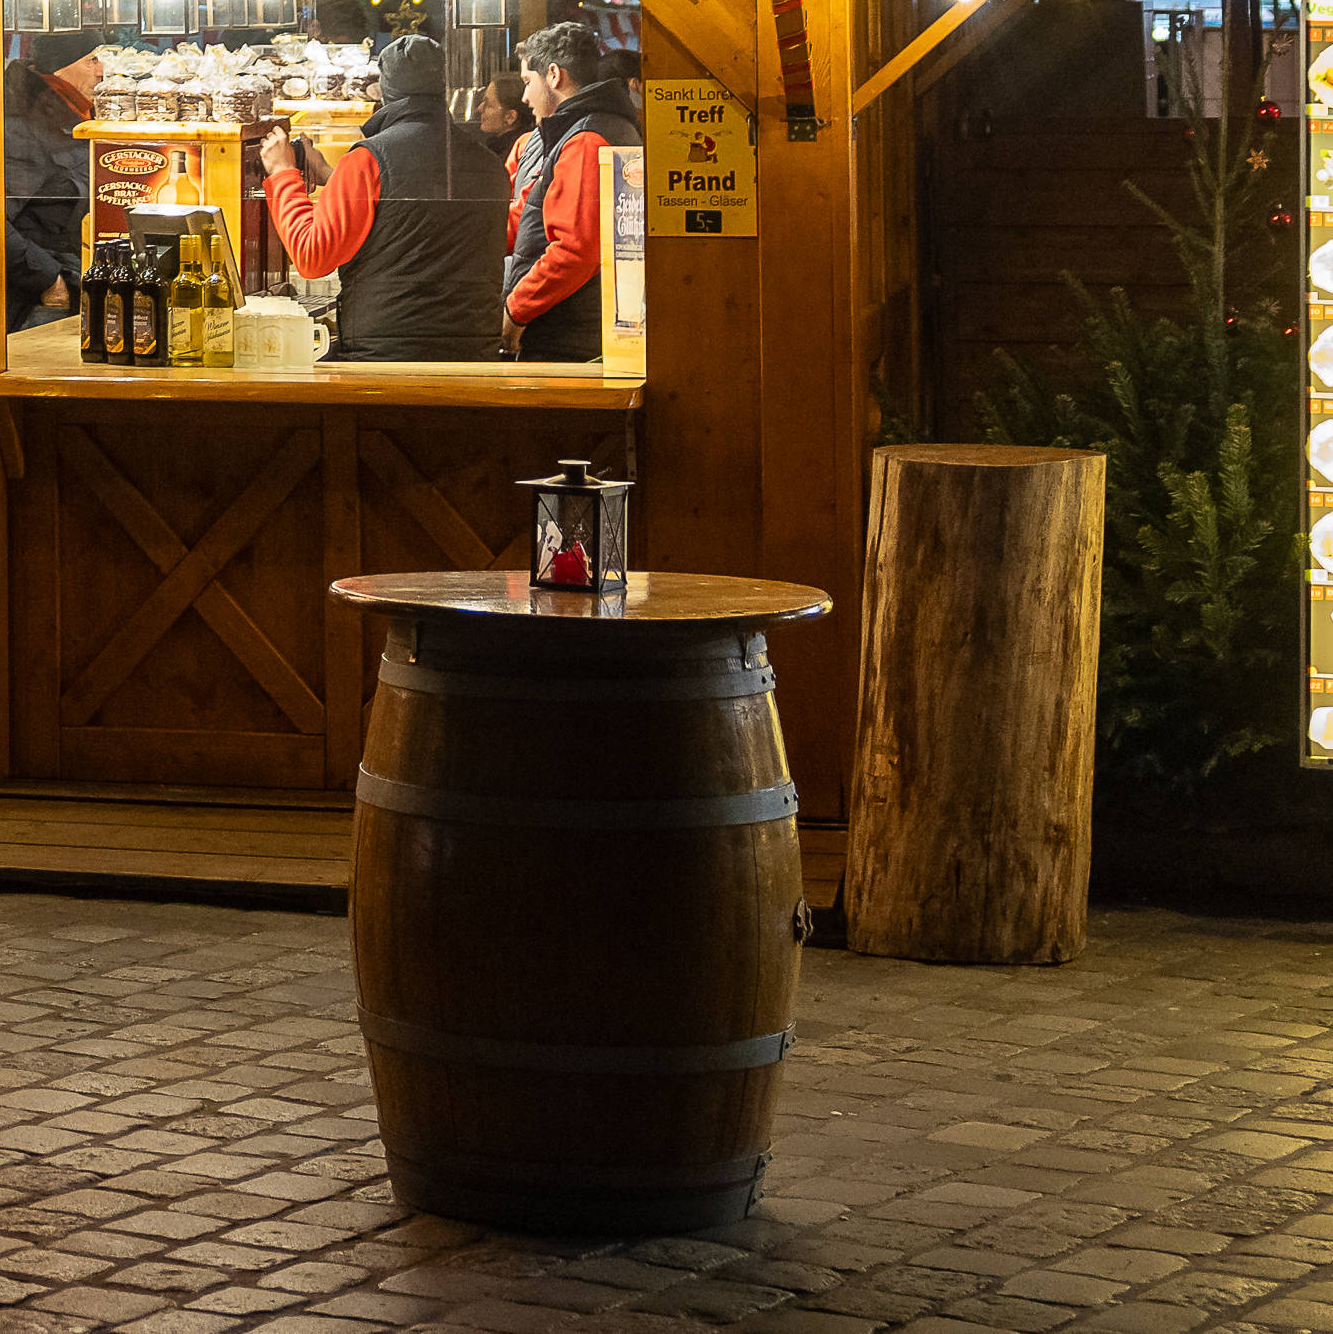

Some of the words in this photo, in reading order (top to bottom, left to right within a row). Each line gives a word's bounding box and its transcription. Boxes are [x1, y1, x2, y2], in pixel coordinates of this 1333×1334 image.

[654, 88, 694, 101] Sankt
[676, 106, 725, 123] Treff
[104, 151, 163, 165] GERSTACKER
[98, 181, 153, 194] GERSTACKER
[668, 170, 736, 192] Pfand
[657, 195, 698, 207] Tassen
[709, 195, 749, 207] Gläser
